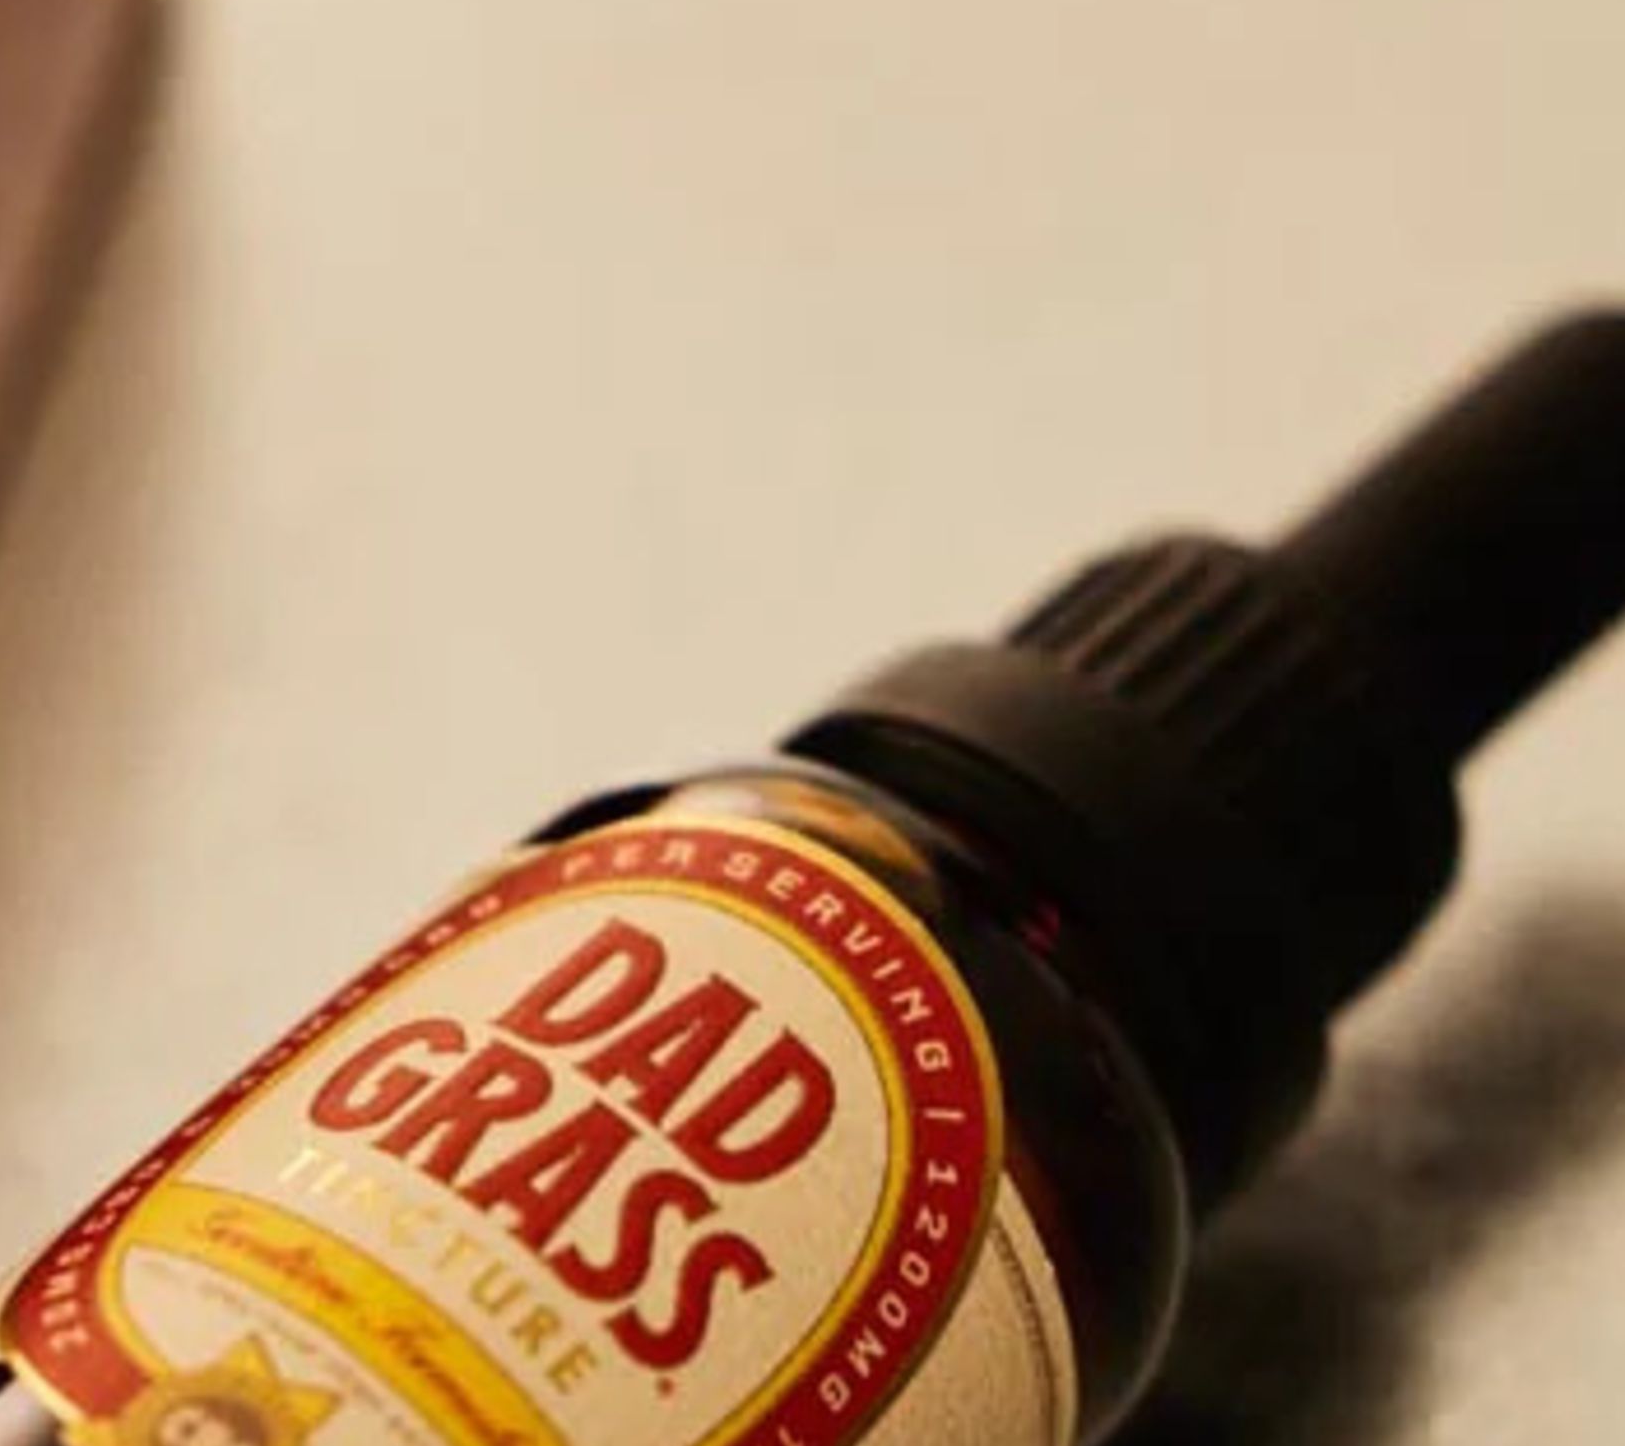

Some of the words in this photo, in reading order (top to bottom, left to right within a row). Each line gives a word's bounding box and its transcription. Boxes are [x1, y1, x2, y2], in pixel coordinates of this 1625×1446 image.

[490, 915, 838, 1185] DAD
[722, 850, 950, 1073] SERVING
[307, 1018, 774, 1370] GRASS
[817, 1159, 960, 1414] 1200MG
